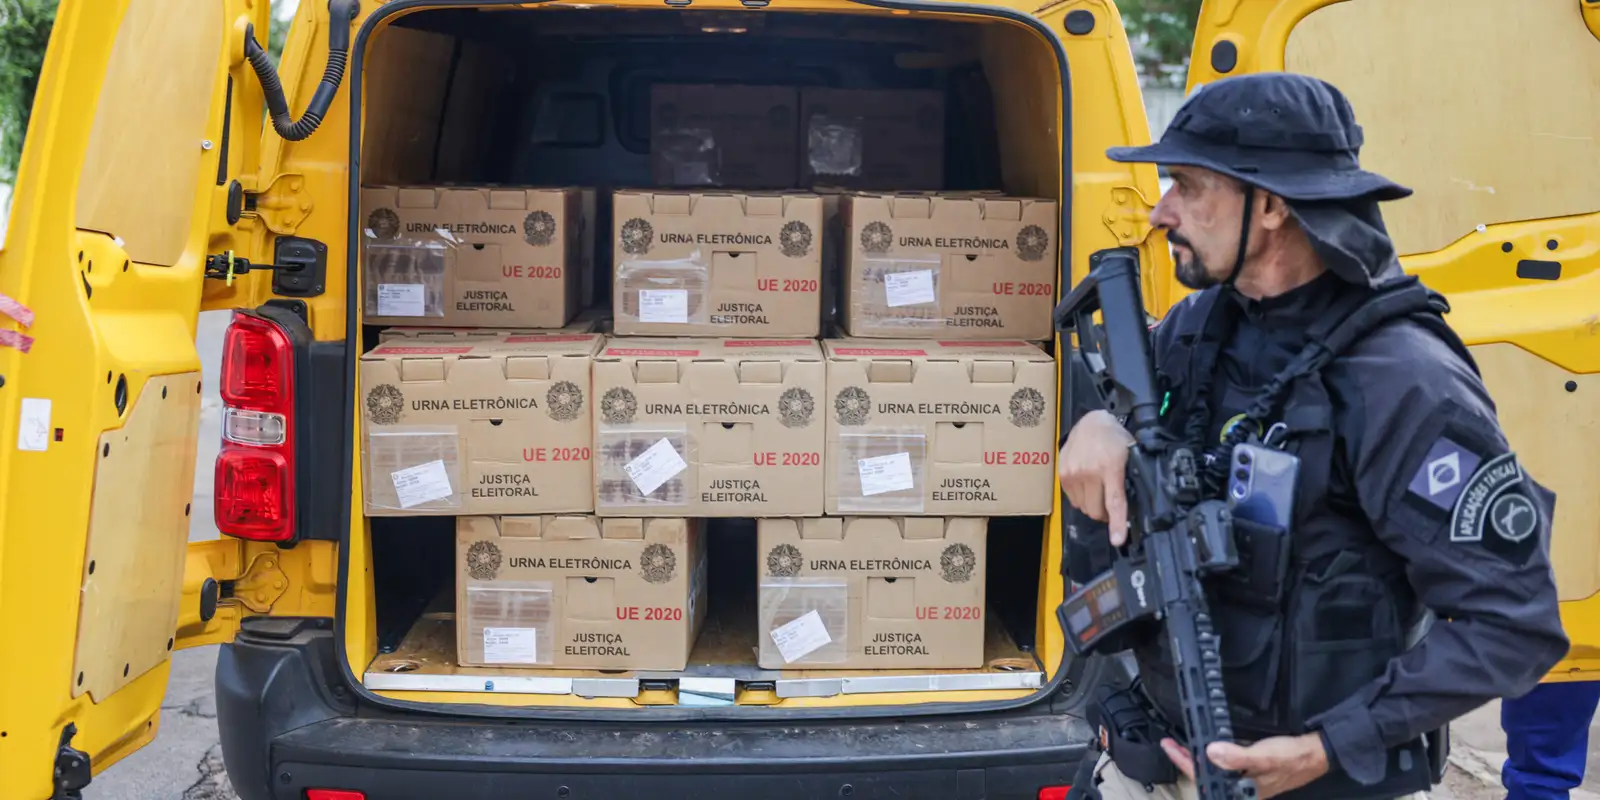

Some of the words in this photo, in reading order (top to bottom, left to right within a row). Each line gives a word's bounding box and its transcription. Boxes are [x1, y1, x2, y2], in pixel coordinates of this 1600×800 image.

[406, 223, 438, 233] URNA
[441, 222, 516, 234] ELETRÔNICA
[660, 233, 694, 243] URNA
[696, 233, 772, 245] ELETRÔNICA
[899, 237, 932, 247] URNA
[935, 237, 1009, 249] ELETRÔNICA
[503, 265, 522, 278] UE
[528, 266, 561, 279] 2020
[758, 279, 778, 291] UE
[783, 280, 817, 292] 2020
[993, 282, 1013, 295] UE
[1018, 283, 1052, 296] 2020
[463, 291, 508, 301] JUSTIÇA
[456, 302, 515, 311] ELEITORAL
[717, 303, 763, 313] JUSTIÇA
[954, 307, 998, 317] JUSTIÇA
[710, 315, 770, 324] ELEITORAL
[946, 318, 1005, 328] ELEITORAL
[412, 400, 450, 411] URNA
[453, 397, 538, 410] ELETRÔNICA
[645, 404, 682, 415] URNA
[686, 402, 770, 415] ELETRÔNICA
[878, 403, 915, 414] URNA
[919, 401, 1001, 414] ELETRÔNICA
[523, 448, 546, 462] UE
[552, 447, 590, 461] 2020
[753, 452, 777, 466] UE
[782, 452, 820, 466] 2020
[984, 452, 1007, 465] UE
[1012, 452, 1050, 465] 2020
[479, 474, 531, 485] JUSTIÇA
[710, 480, 760, 491] JUSTIÇA
[940, 479, 990, 491] JUSTIÇA
[472, 487, 539, 497] ELEITORAL
[702, 493, 768, 502] ELEITORAL
[932, 492, 997, 501] ELEITORAL
[509, 557, 546, 568] URNA
[549, 557, 632, 570] ELETRÔNICA
[811, 560, 847, 570] URNA
[850, 557, 932, 570] ELETRÔNICA
[616, 607, 639, 620] UE
[644, 607, 682, 621] 2020
[916, 607, 938, 620] UE
[944, 607, 981, 620] 2020
[573, 634, 622, 645] JUSTIÇA
[873, 633, 922, 644] JUSTIÇA
[565, 646, 631, 656] ELEITORAL
[864, 646, 930, 655] ELEITORAL
